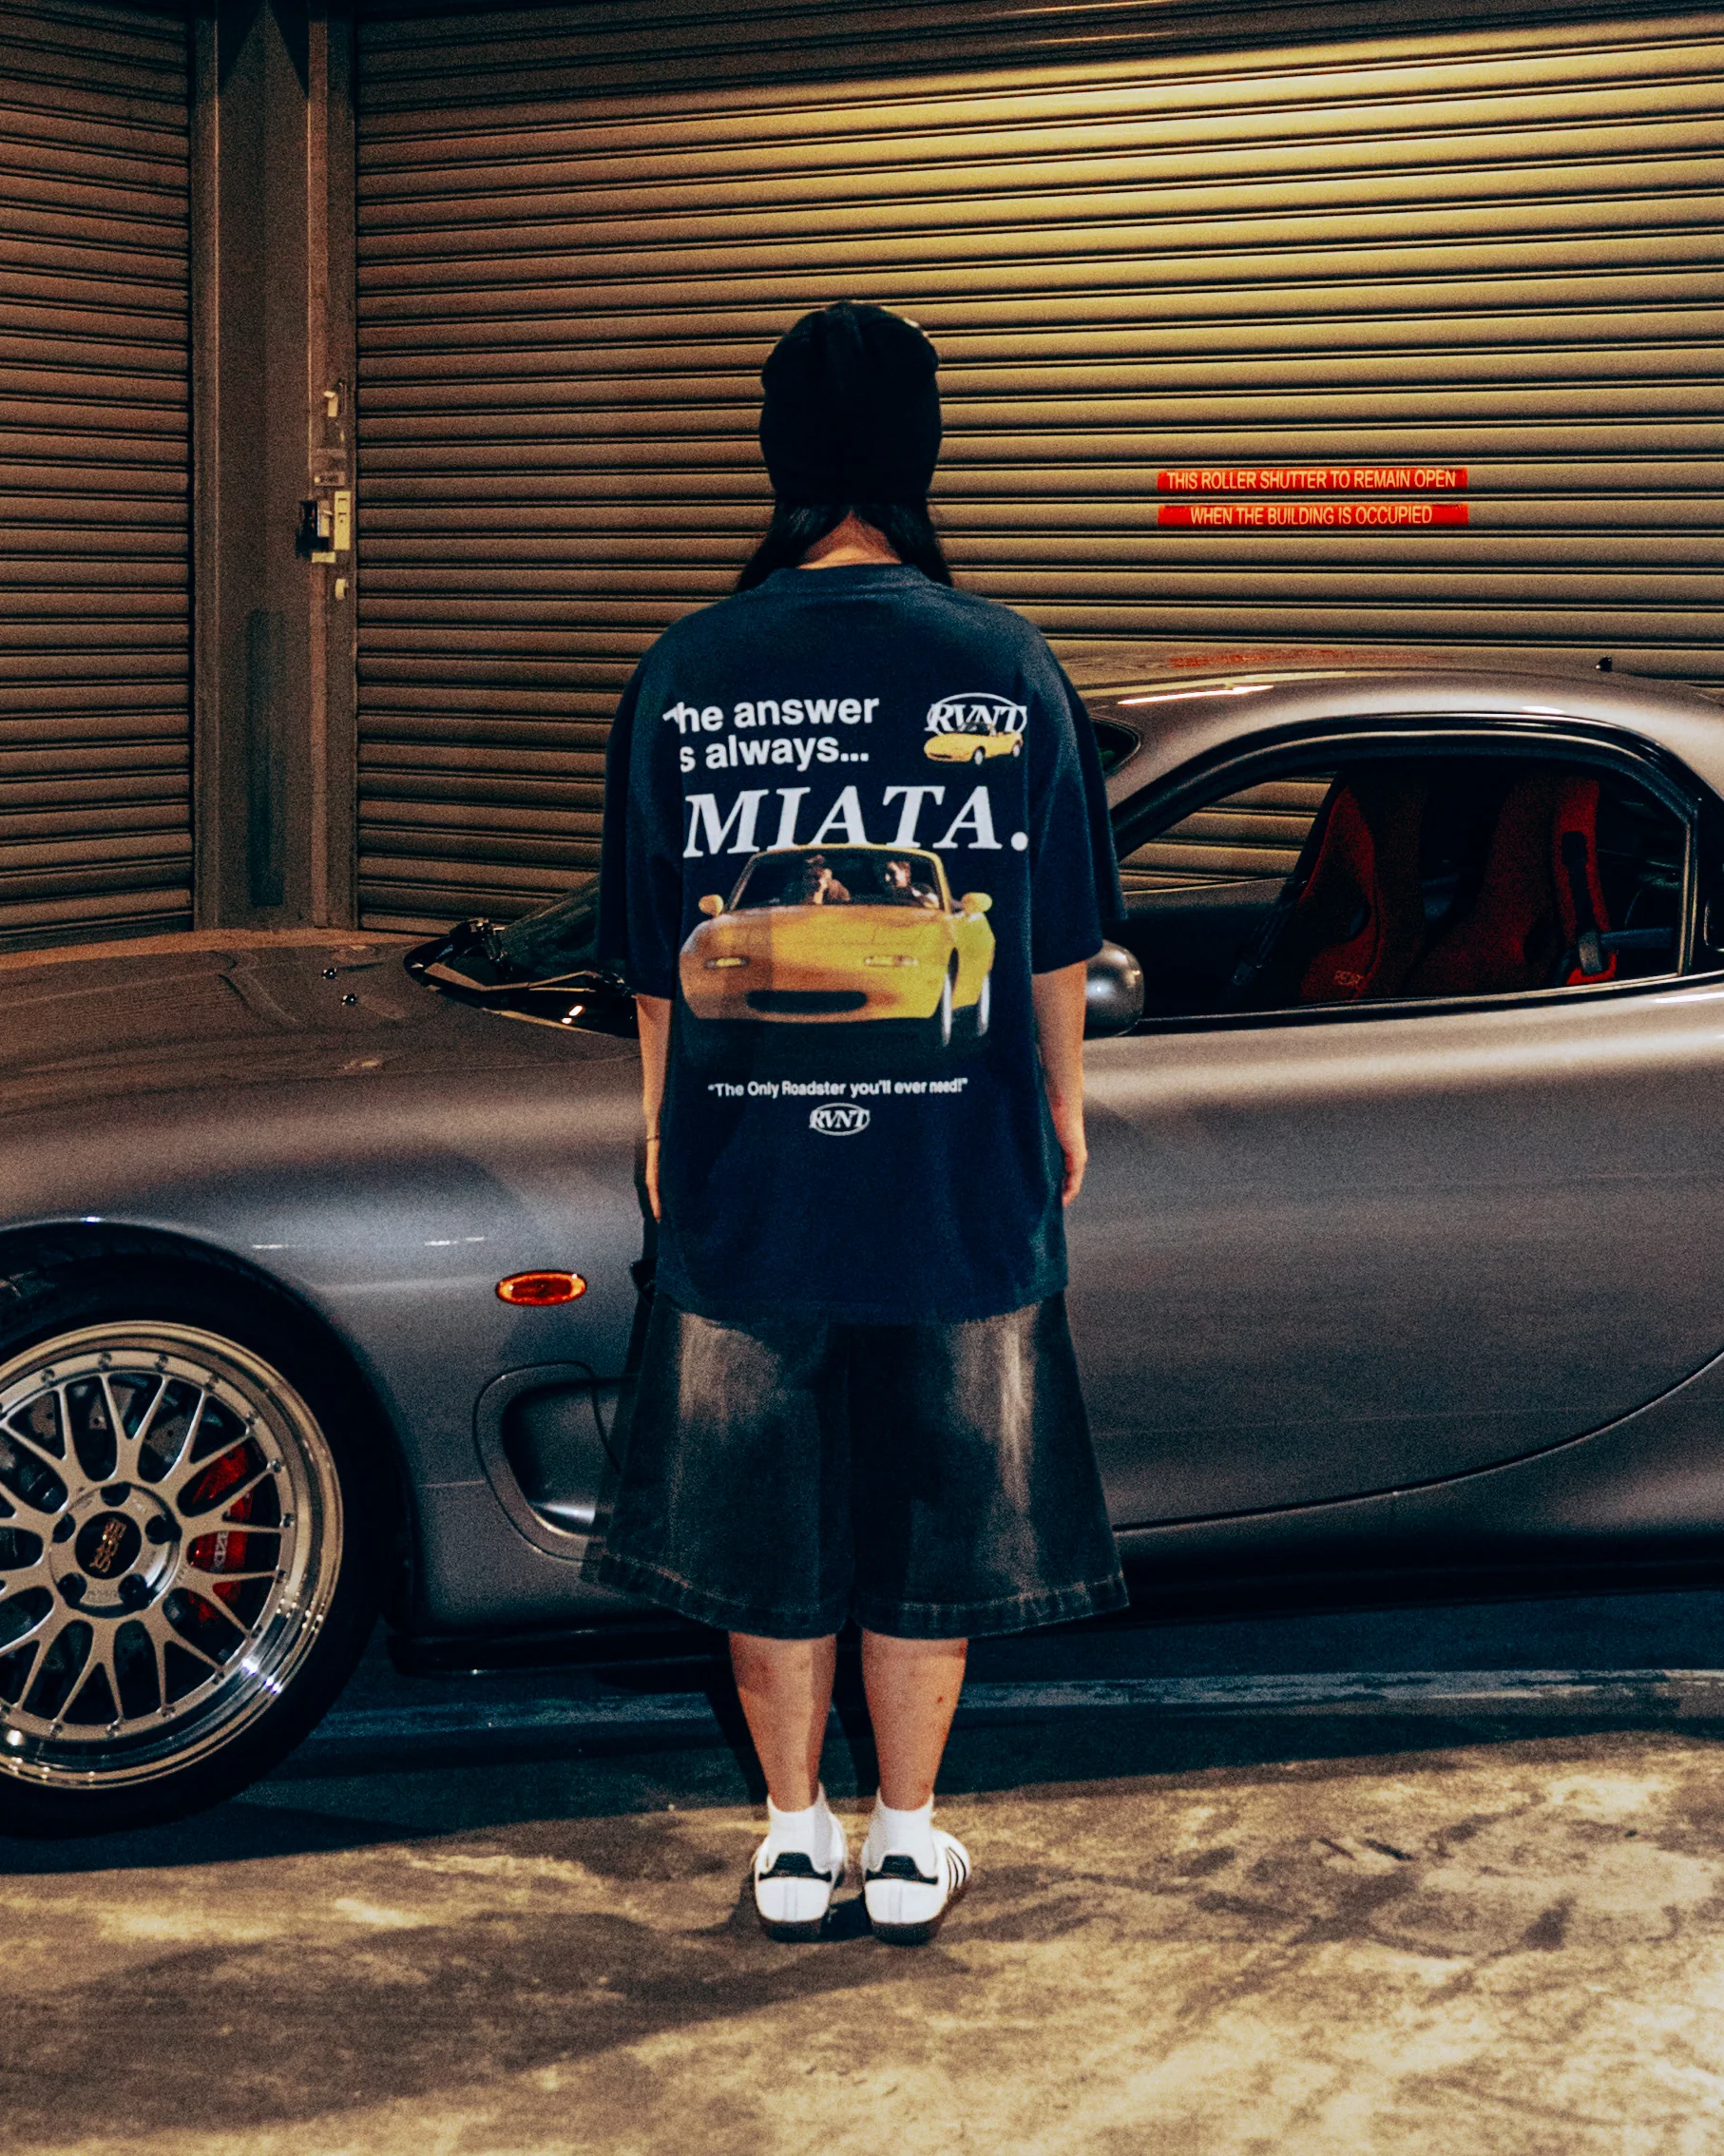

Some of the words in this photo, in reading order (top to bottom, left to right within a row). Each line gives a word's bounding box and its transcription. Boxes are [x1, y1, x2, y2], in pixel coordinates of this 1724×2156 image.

[1167, 471, 1198, 490] THIS
[1200, 471, 1256, 490] ROLLER
[1260, 470, 1327, 490] SHUTTER
[1330, 470, 1350, 489] TO
[1353, 470, 1411, 489] REMAIN
[1414, 469, 1456, 488] OPEN
[1190, 506, 1234, 525] WHEN
[1236, 506, 1264, 525] THE
[1267, 506, 1334, 525] BUILDING
[1338, 506, 1352, 524] IS
[1355, 505, 1433, 524] OCCUPIED
[735, 698, 880, 728] answer
[705, 734, 870, 772] always...
[682, 785, 1029, 858] MIATA.
[747, 1081, 780, 1099] Only
[781, 1080, 847, 1096] Roadster
[850, 1079, 891, 1099] you'll
[893, 1081, 928, 1094] ever
[809, 1109, 871, 1129] RVNT
